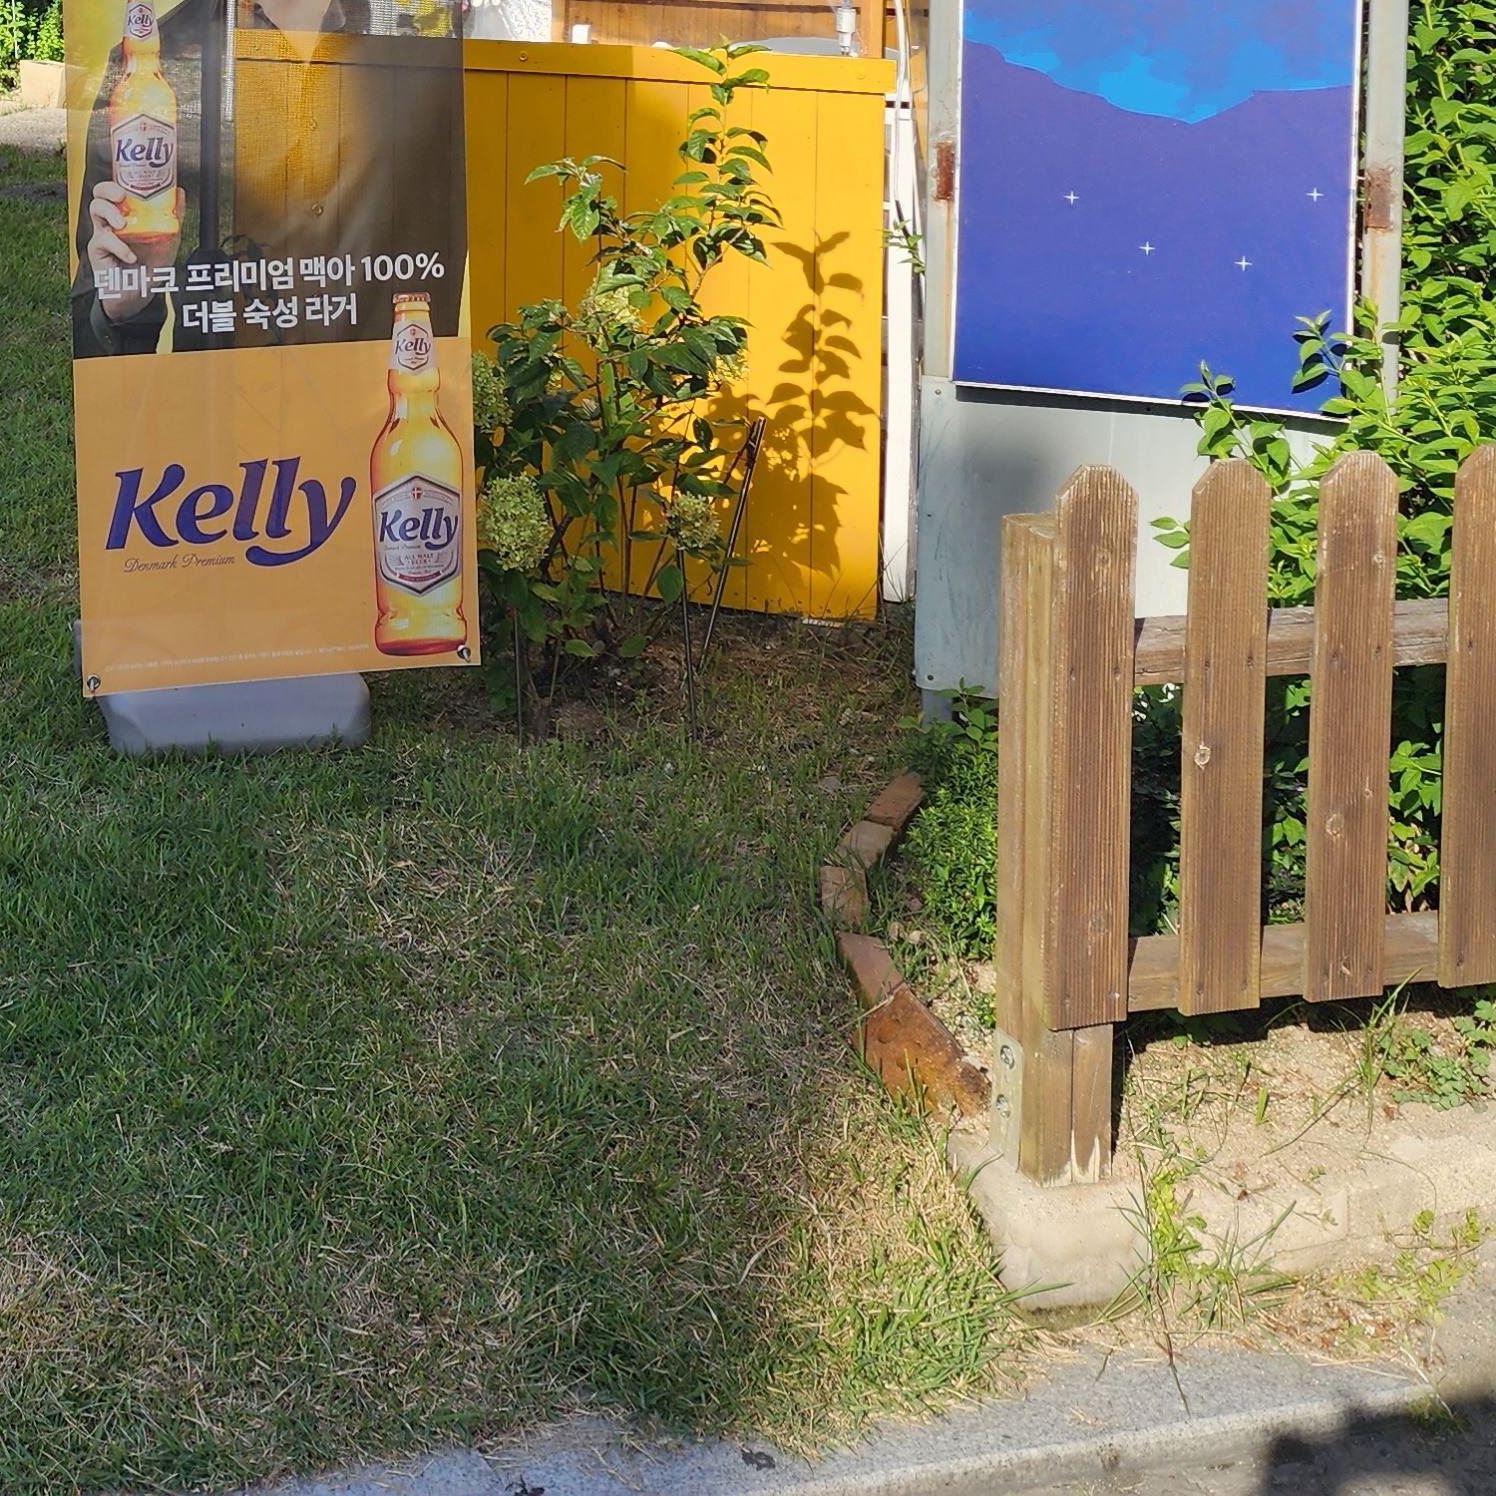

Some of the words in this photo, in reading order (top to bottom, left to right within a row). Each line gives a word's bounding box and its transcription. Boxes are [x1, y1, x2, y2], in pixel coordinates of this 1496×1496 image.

[127, 14, 154, 28] Kelly
[115, 136, 174, 168] Kelly
[94, 265, 179, 300] 덴마크
[185, 258, 294, 293] 프리미엄
[299, 254, 356, 287] 맥아
[361, 251, 445, 281] 100%
[182, 301, 237, 333] 더블
[242, 295, 298, 330] 숙성
[305, 292, 358, 326] 라거
[395, 338, 431, 355] Kelly
[104, 456, 357, 567] Kelly
[379, 506, 459, 551] Kelly
[124, 554, 179, 573] Denmark
[182, 553, 235, 568] Premium
